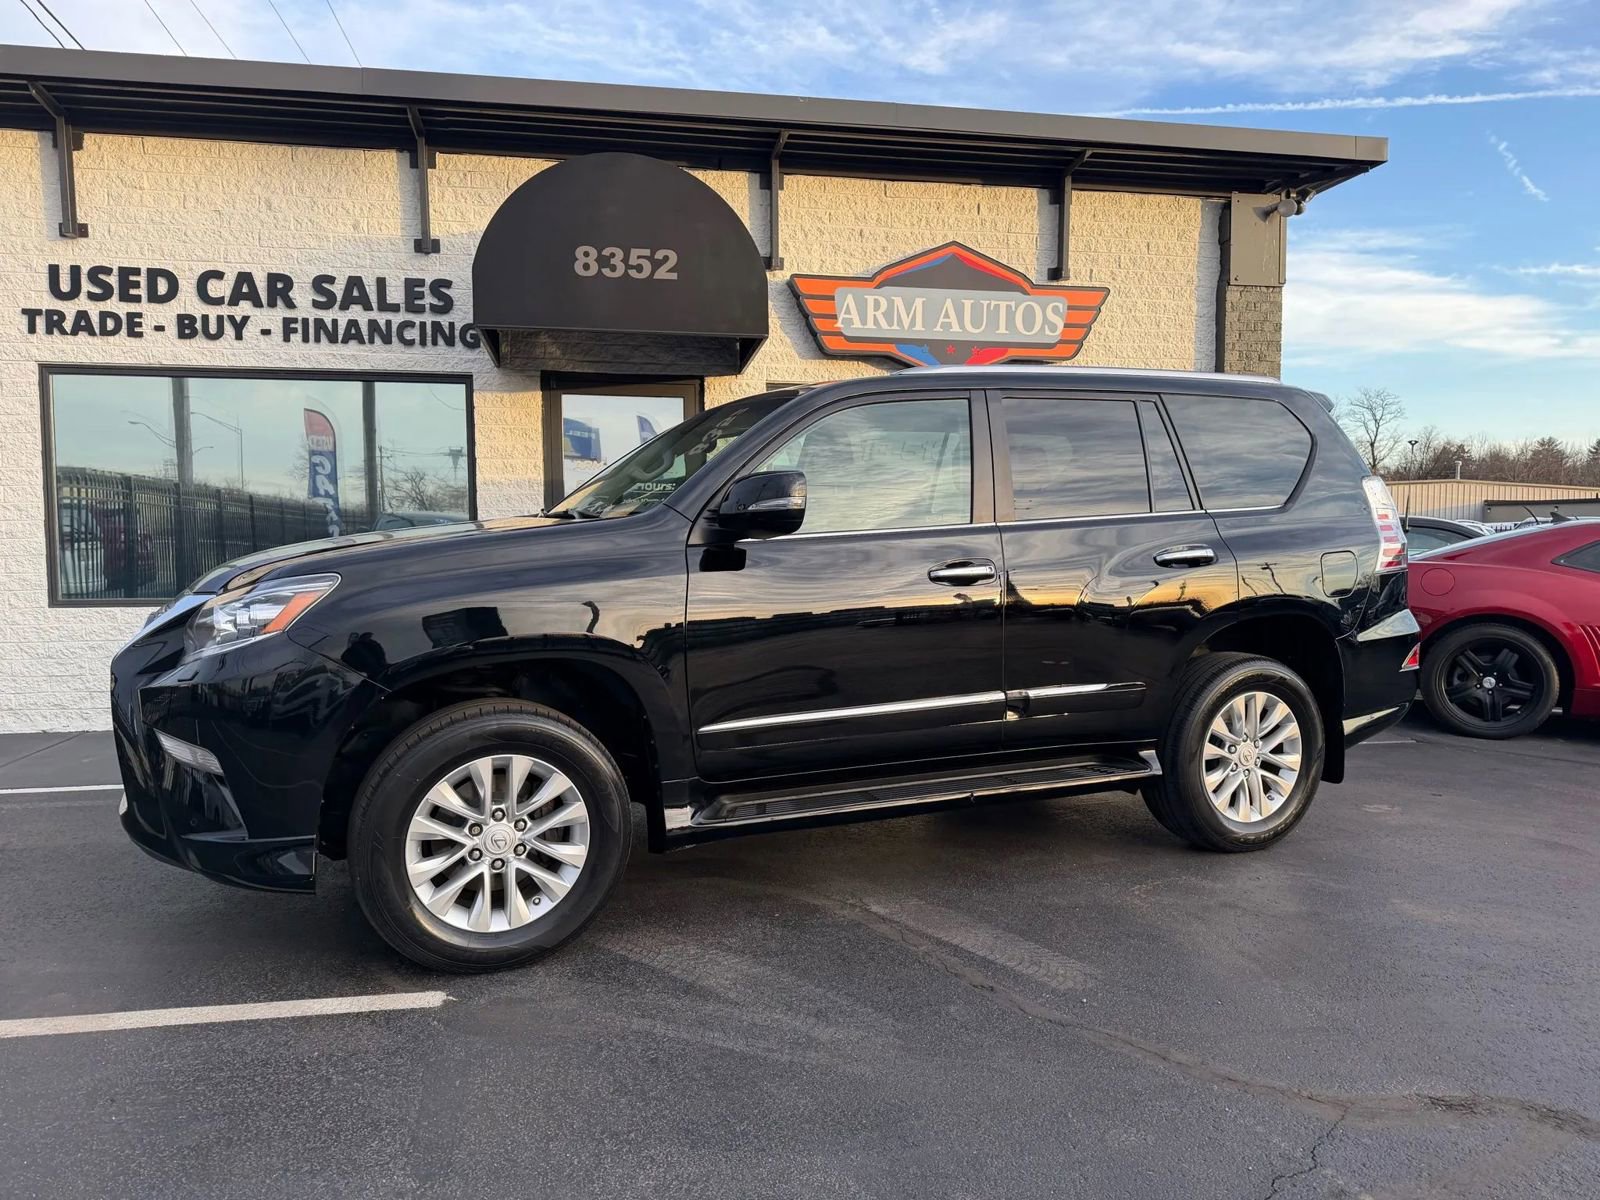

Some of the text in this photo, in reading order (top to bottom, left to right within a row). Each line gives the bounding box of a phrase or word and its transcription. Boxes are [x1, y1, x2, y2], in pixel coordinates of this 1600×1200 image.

[574, 245, 678, 280] 8352
[48, 263, 454, 316] USED CAR SALES
[21, 308, 144, 339] TRADE
[176, 313, 251, 341] BUY
[282, 316, 481, 349] FINANCING
[834, 293, 1064, 337] ARM AUTOS
